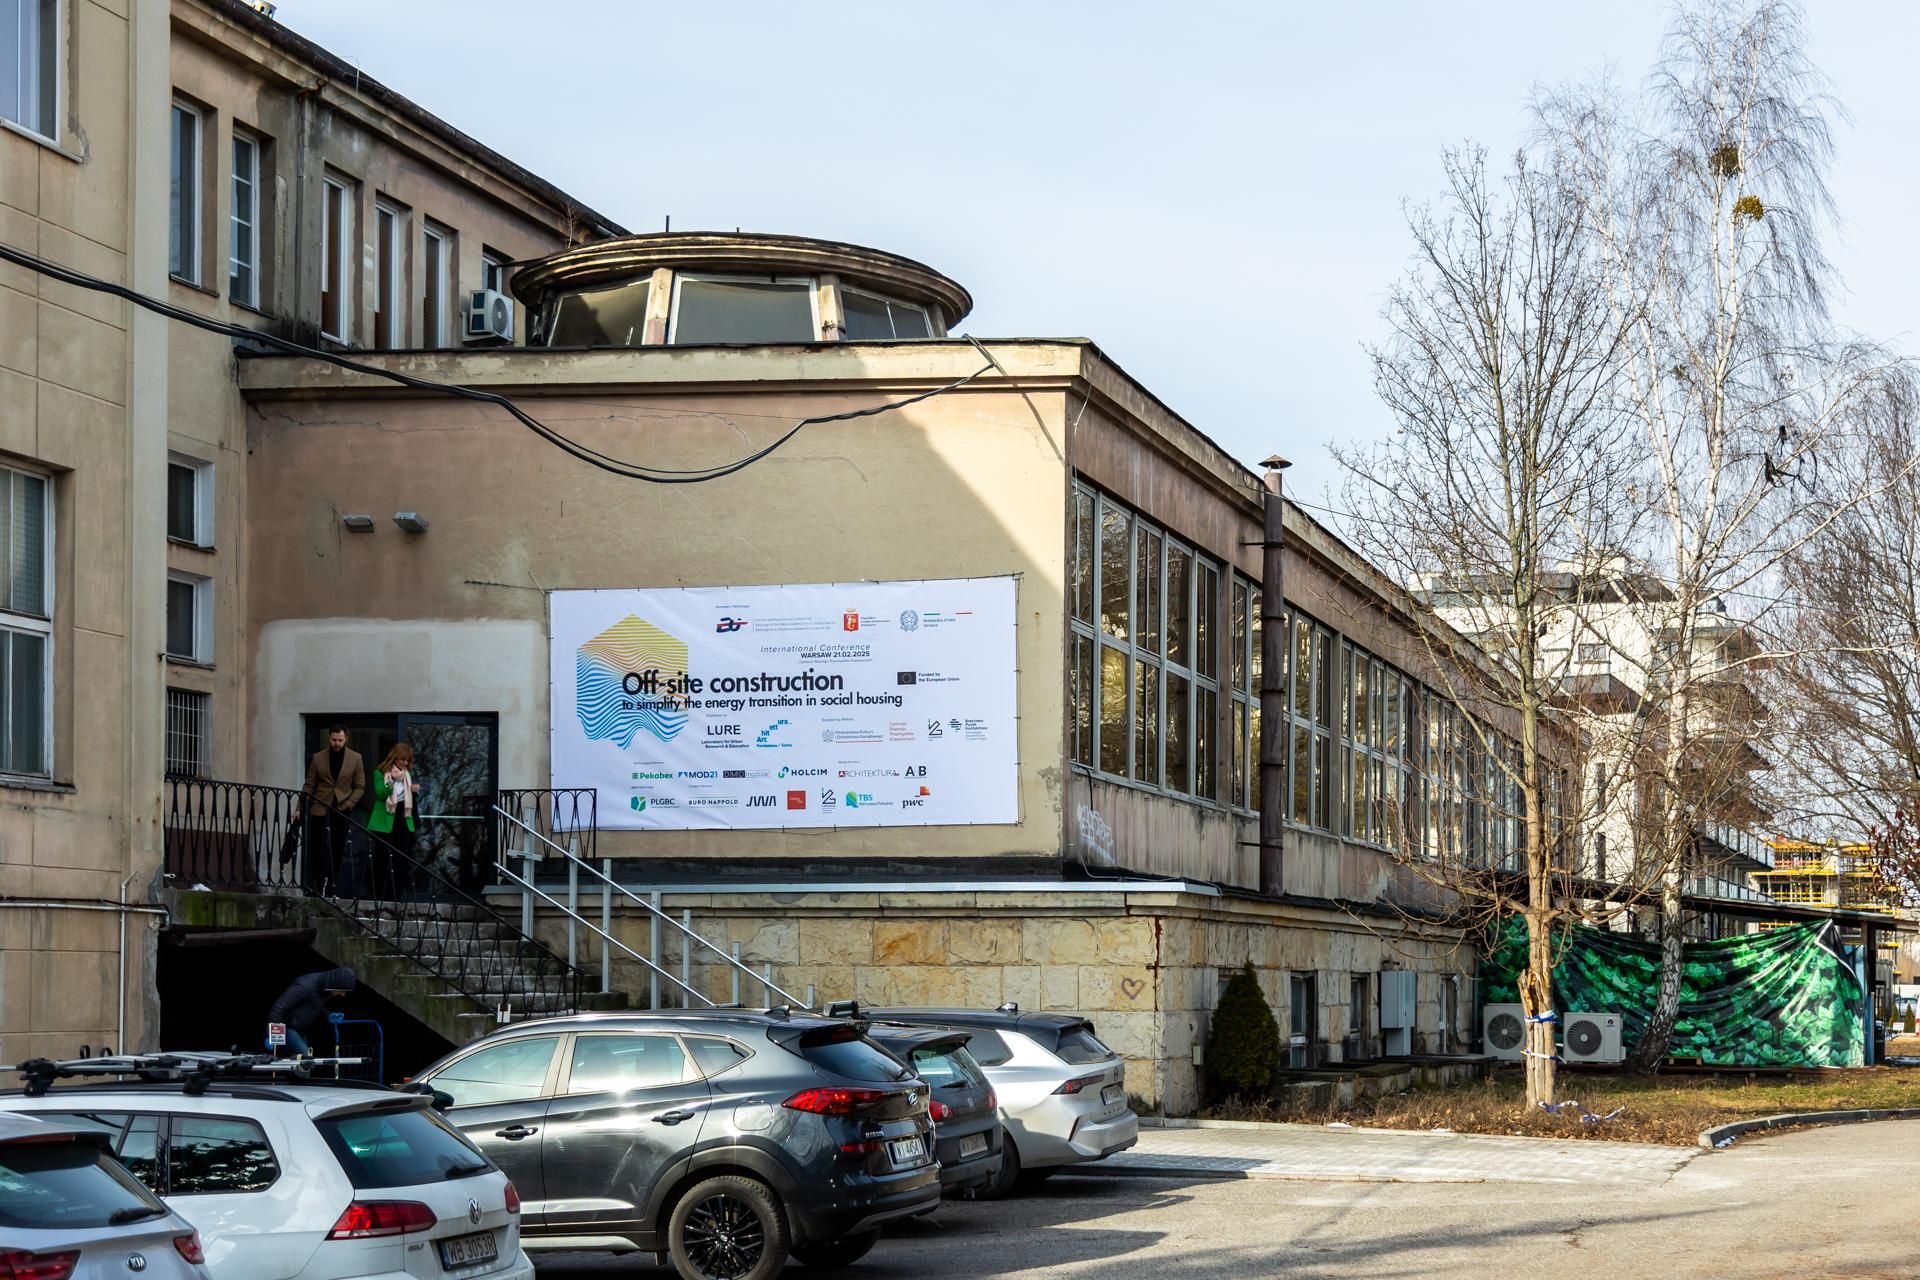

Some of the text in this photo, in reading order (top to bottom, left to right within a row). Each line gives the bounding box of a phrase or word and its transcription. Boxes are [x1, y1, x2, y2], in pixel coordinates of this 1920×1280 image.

[760, 643, 871, 653] International Conference
[833, 650, 870, 658] 21.02.2025
[622, 667, 844, 696] Off-site construction
[622, 691, 903, 713] to simplify the energy transition in social housing
[707, 724, 741, 736] LURE
[689, 771, 718, 779] MOD21
[651, 798, 675, 806] PLGBC
[902, 799, 924, 808] pwc
[448, 1235, 495, 1262] WB 3053R
